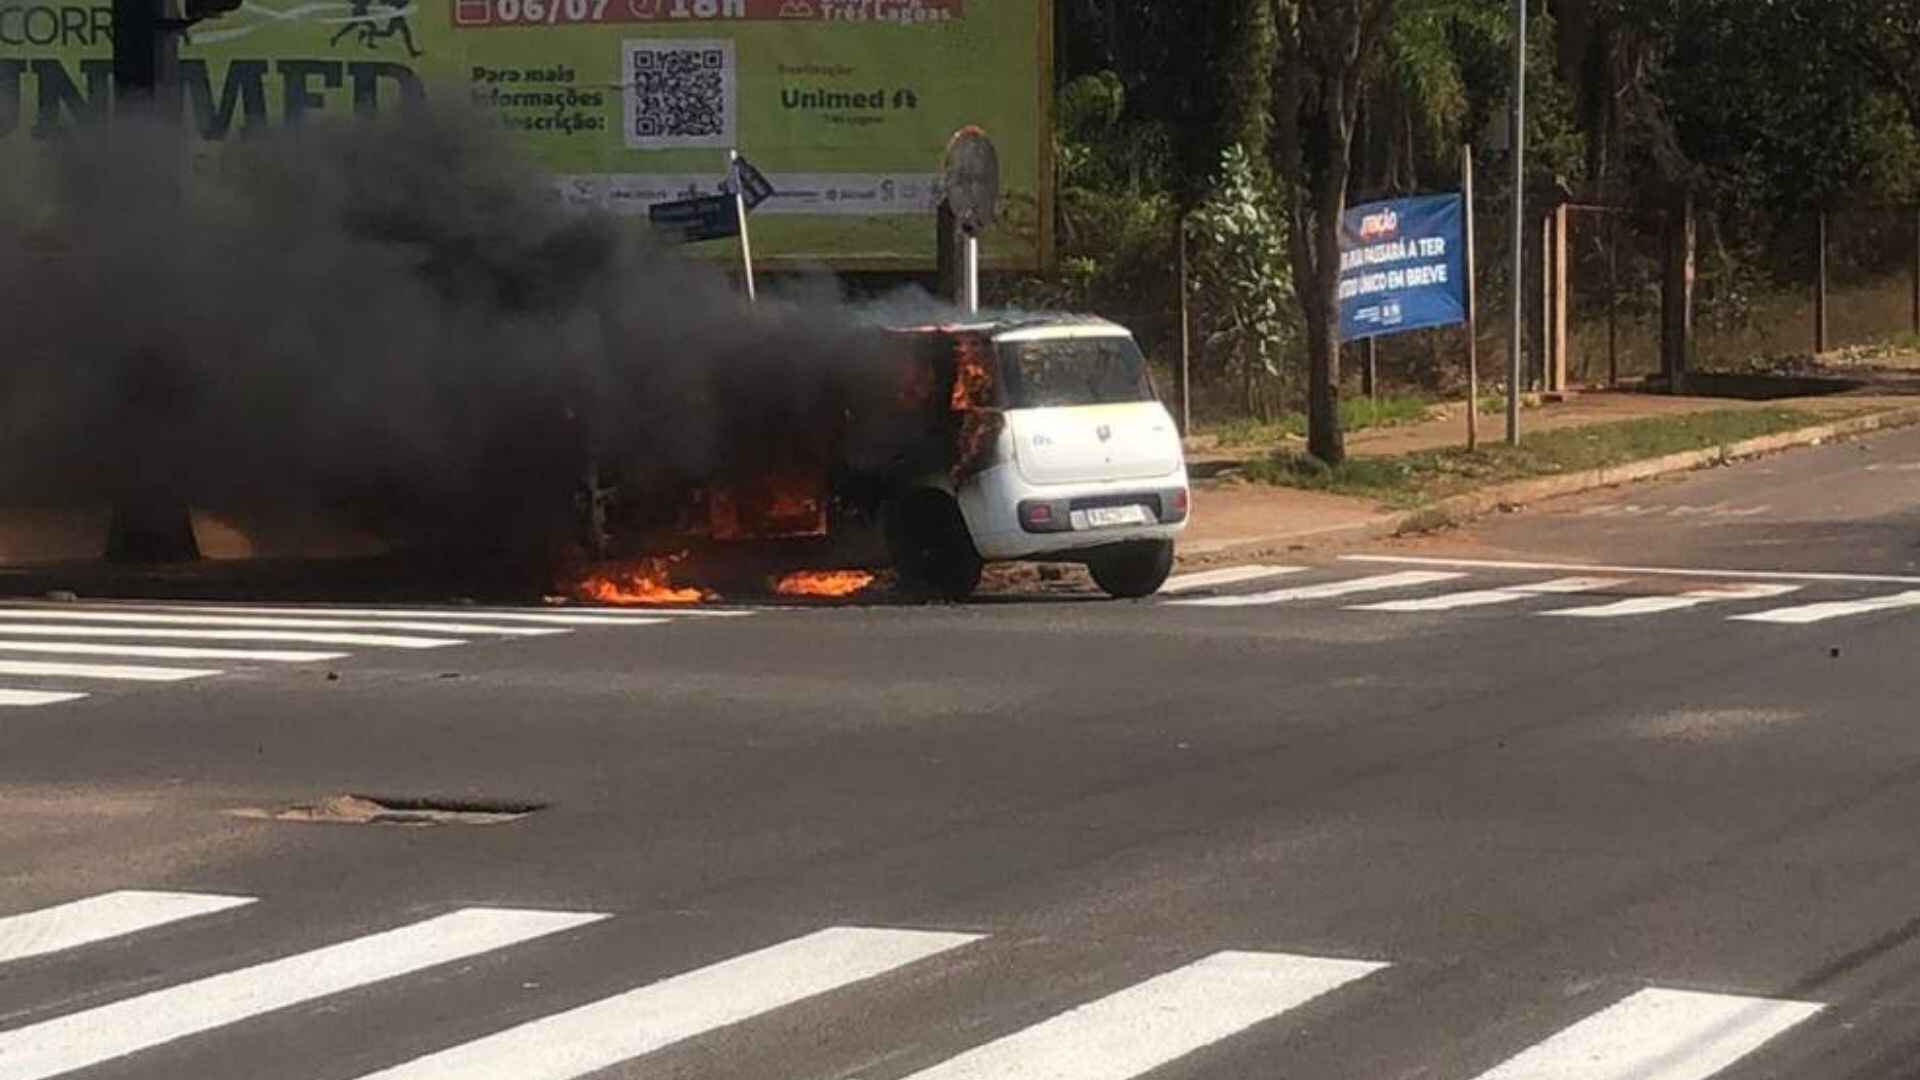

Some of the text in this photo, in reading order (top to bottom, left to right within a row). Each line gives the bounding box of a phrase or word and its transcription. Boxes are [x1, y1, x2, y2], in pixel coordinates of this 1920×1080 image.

[499, 0, 608, 22] 06/07
[0, 7, 114, 46] CORR
[472, 64, 576, 83] Para mais
[781, 88, 884, 109] Unimed
[1408, 239, 1418, 258] A
[1418, 237, 1446, 257] TER
[1406, 264, 1448, 286] BREVE
